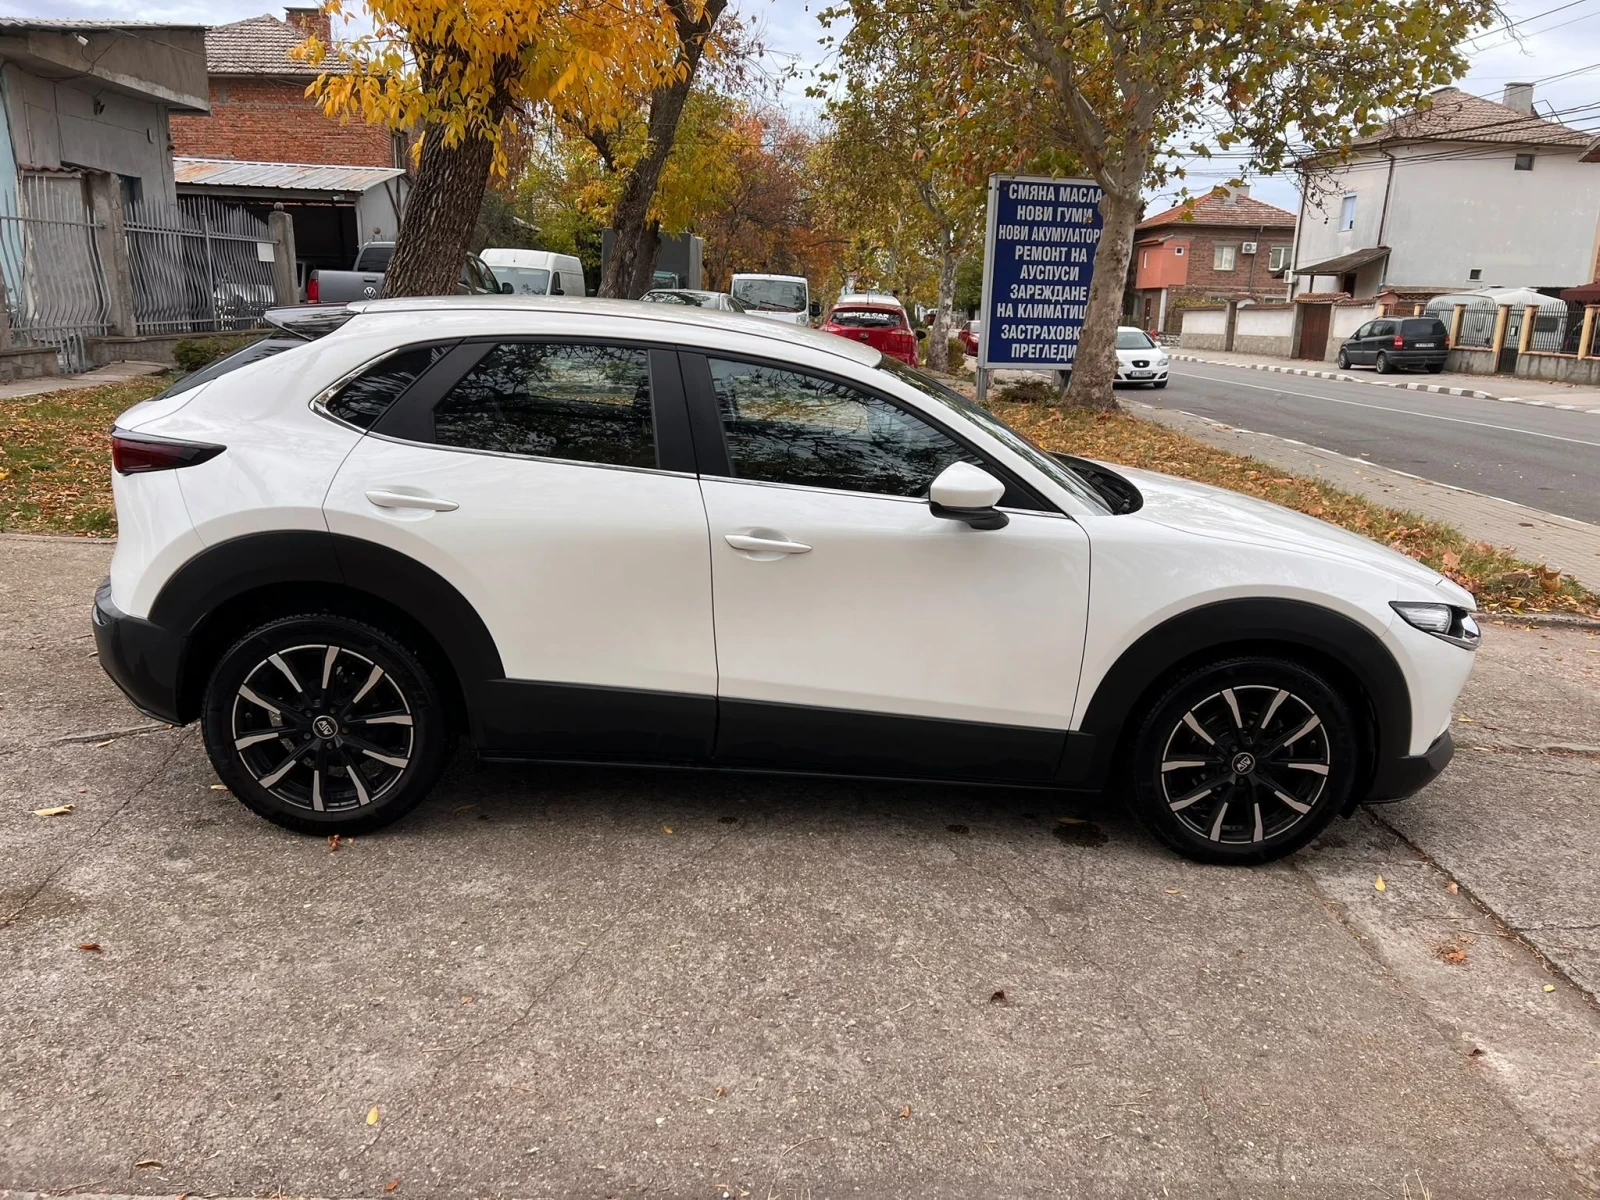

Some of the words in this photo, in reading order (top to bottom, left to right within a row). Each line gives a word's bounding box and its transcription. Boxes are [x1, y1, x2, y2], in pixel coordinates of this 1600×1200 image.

[1009, 184, 1055, 201] СМЯНА
[1059, 187, 1102, 203] МАСЛА
[1017, 205, 1053, 221] НОВИ
[1057, 207, 1093, 223] ГУМИ
[999, 225, 1029, 240] НОВИ
[1031, 226, 1103, 243] АКУМУЛАТОР
[1015, 245, 1068, 262] РЕМОНТ
[1071, 247, 1087, 262] НА
[1020, 265, 1079, 281] АУСПУСИ
[1010, 284, 1087, 303] ЗАРЕЖДАНЕ
[997, 303, 1014, 317] НА
[1017, 303, 1087, 319] КЛИМАТИЦ
[1001, 324, 1081, 340] ЗАСТРАХОВК
[1011, 343, 1077, 361] ПРЕГЛЕДИ
